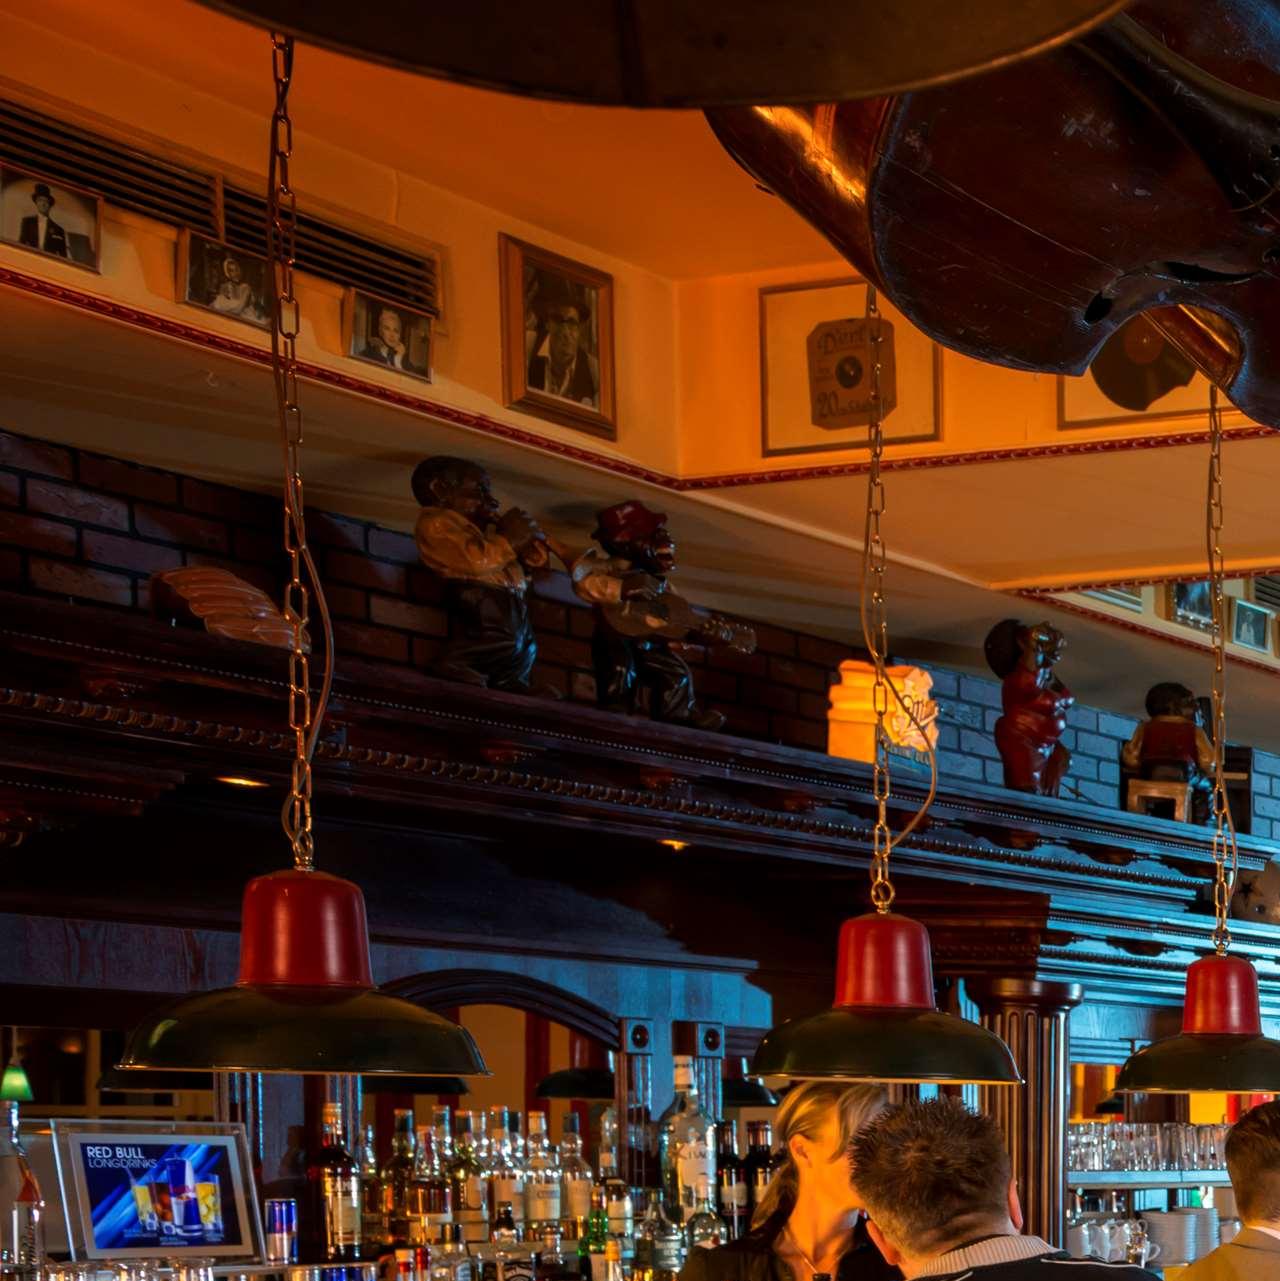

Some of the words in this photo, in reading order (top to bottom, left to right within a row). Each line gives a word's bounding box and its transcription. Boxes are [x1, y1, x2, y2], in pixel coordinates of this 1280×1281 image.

[87, 1146, 112, 1159] RED
[116, 1146, 145, 1159] BULL
[88, 1158, 157, 1169] LONGDRINKS
